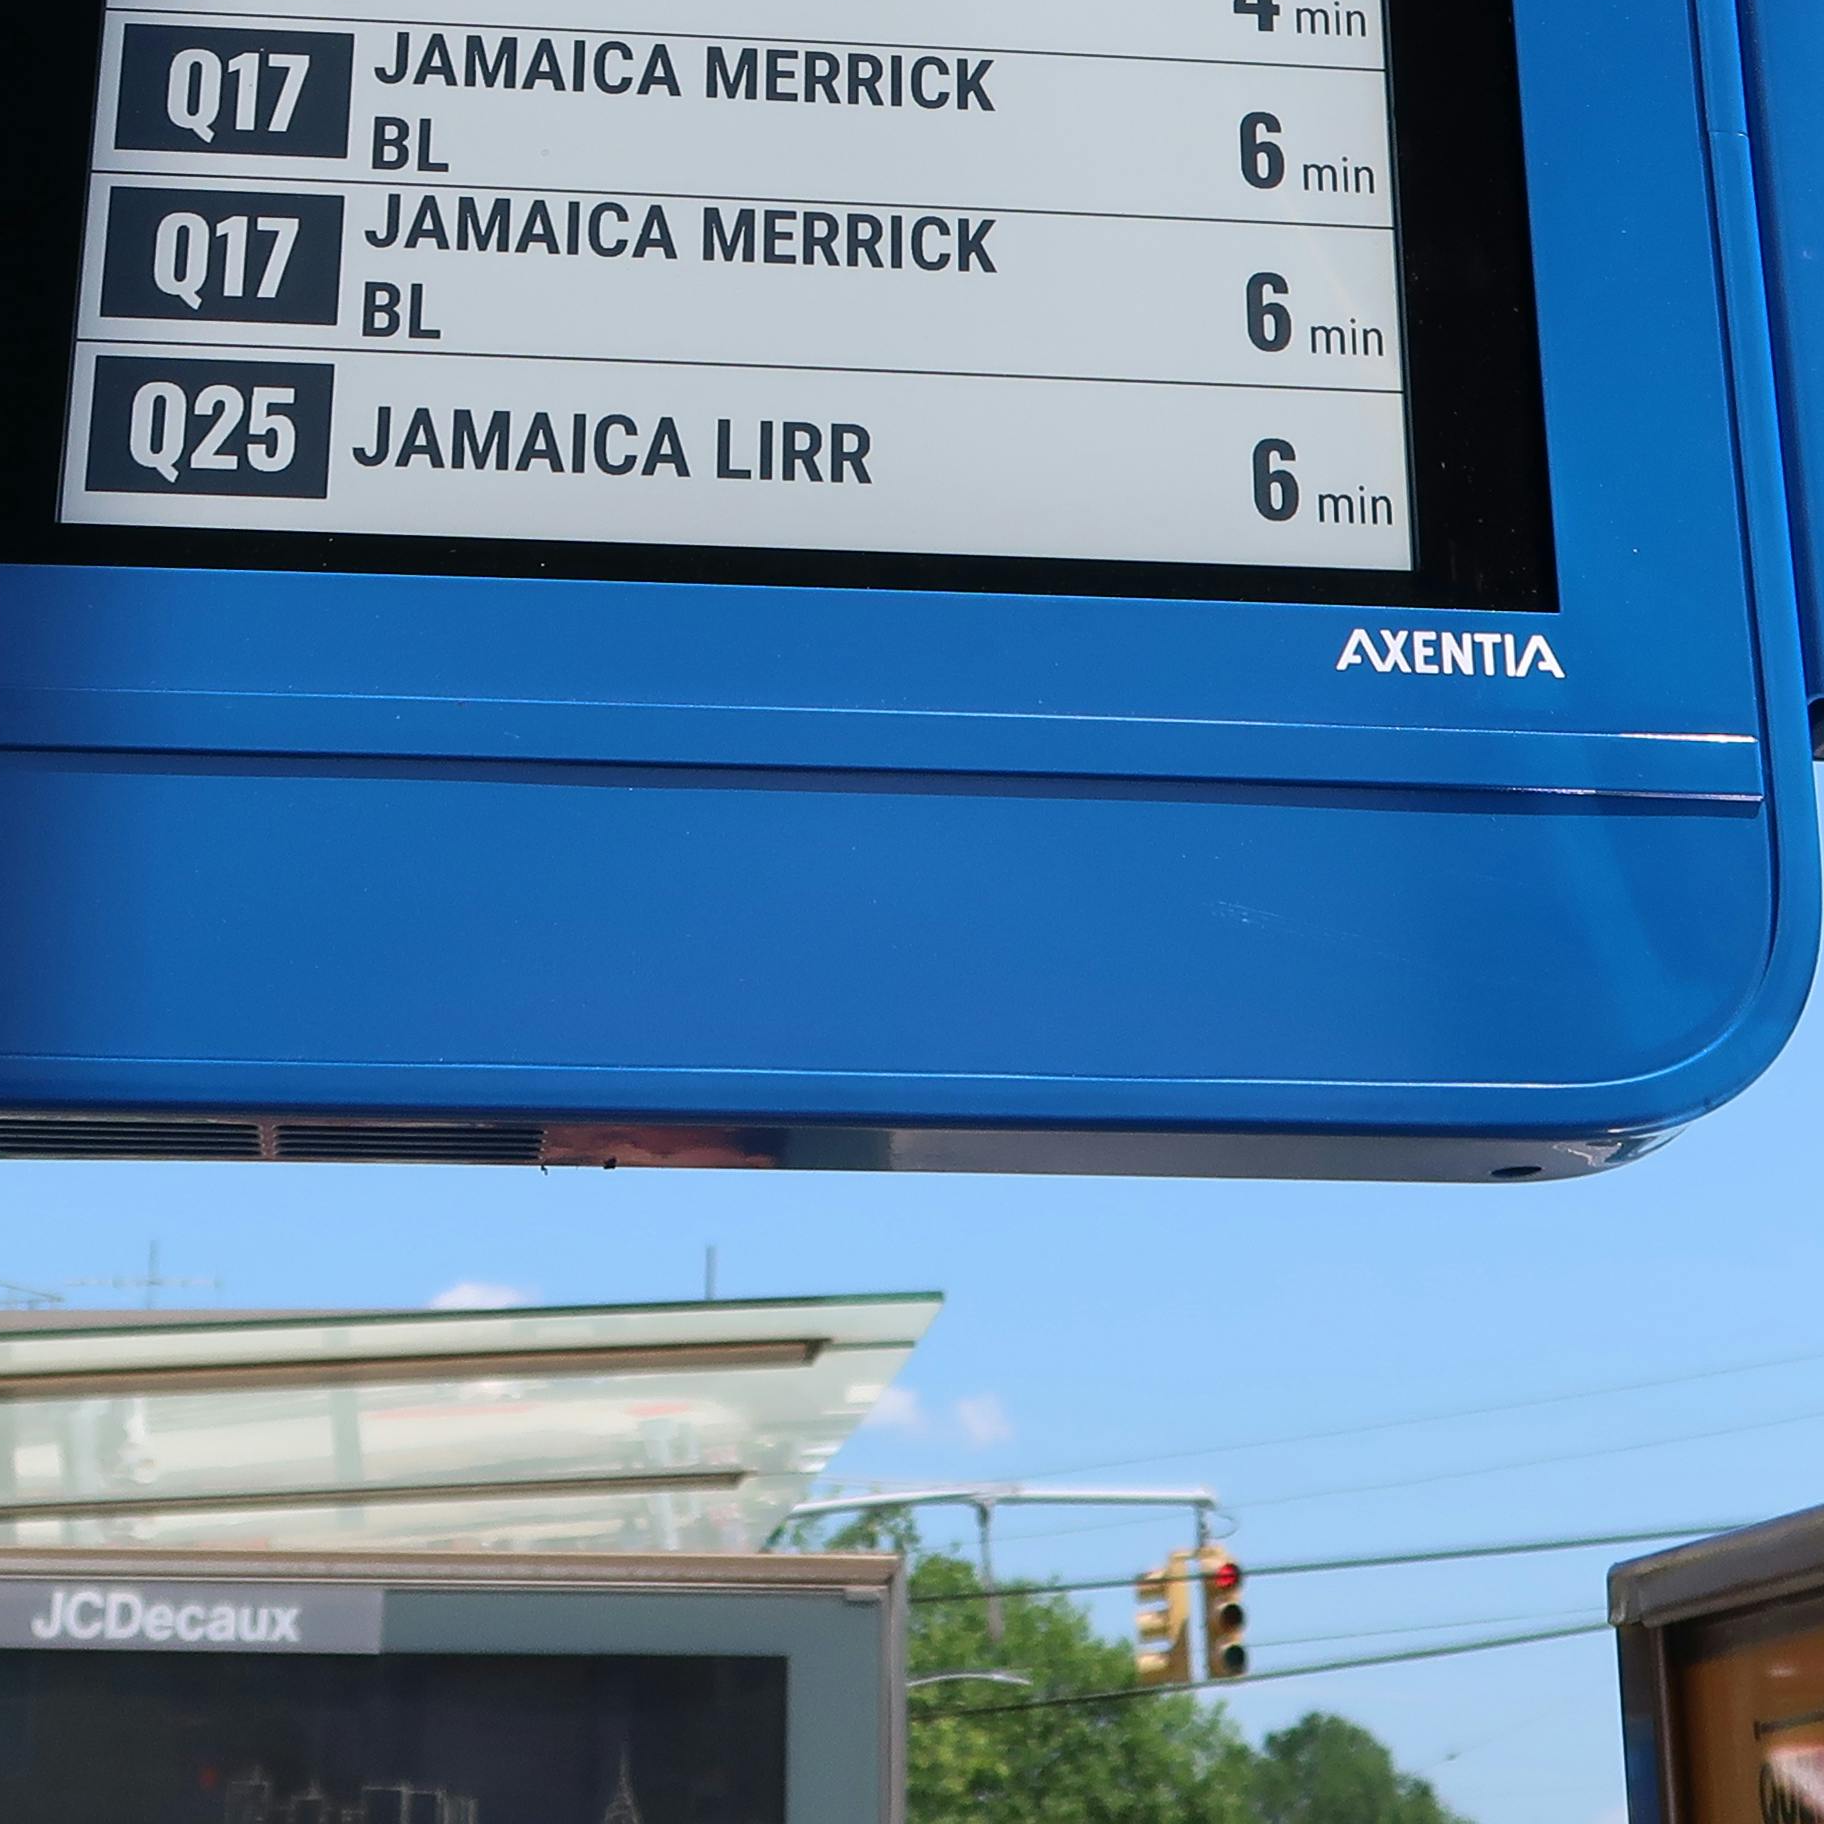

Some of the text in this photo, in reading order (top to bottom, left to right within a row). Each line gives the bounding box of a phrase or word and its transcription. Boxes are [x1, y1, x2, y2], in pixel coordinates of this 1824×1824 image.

[1295, 0, 1367, 37] min
[166, 49, 310, 143] Q17
[374, 32, 995, 111] JAMAICA MERRICK
[371, 116, 449, 173] BL
[1240, 112, 1376, 194] 6 min
[153, 212, 301, 310] Q17
[364, 193, 998, 274] JAMAICA MERRICK
[362, 282, 441, 340] BL
[1246, 272, 1384, 357] 6 min
[129, 382, 297, 483] Q25
[353, 406, 873, 484] JAMAICA LIRR
[1252, 438, 1394, 526] 6 min
[1336, 629, 1566, 679] AXENTIA
[30, 1589, 300, 1643] JCDecaux
